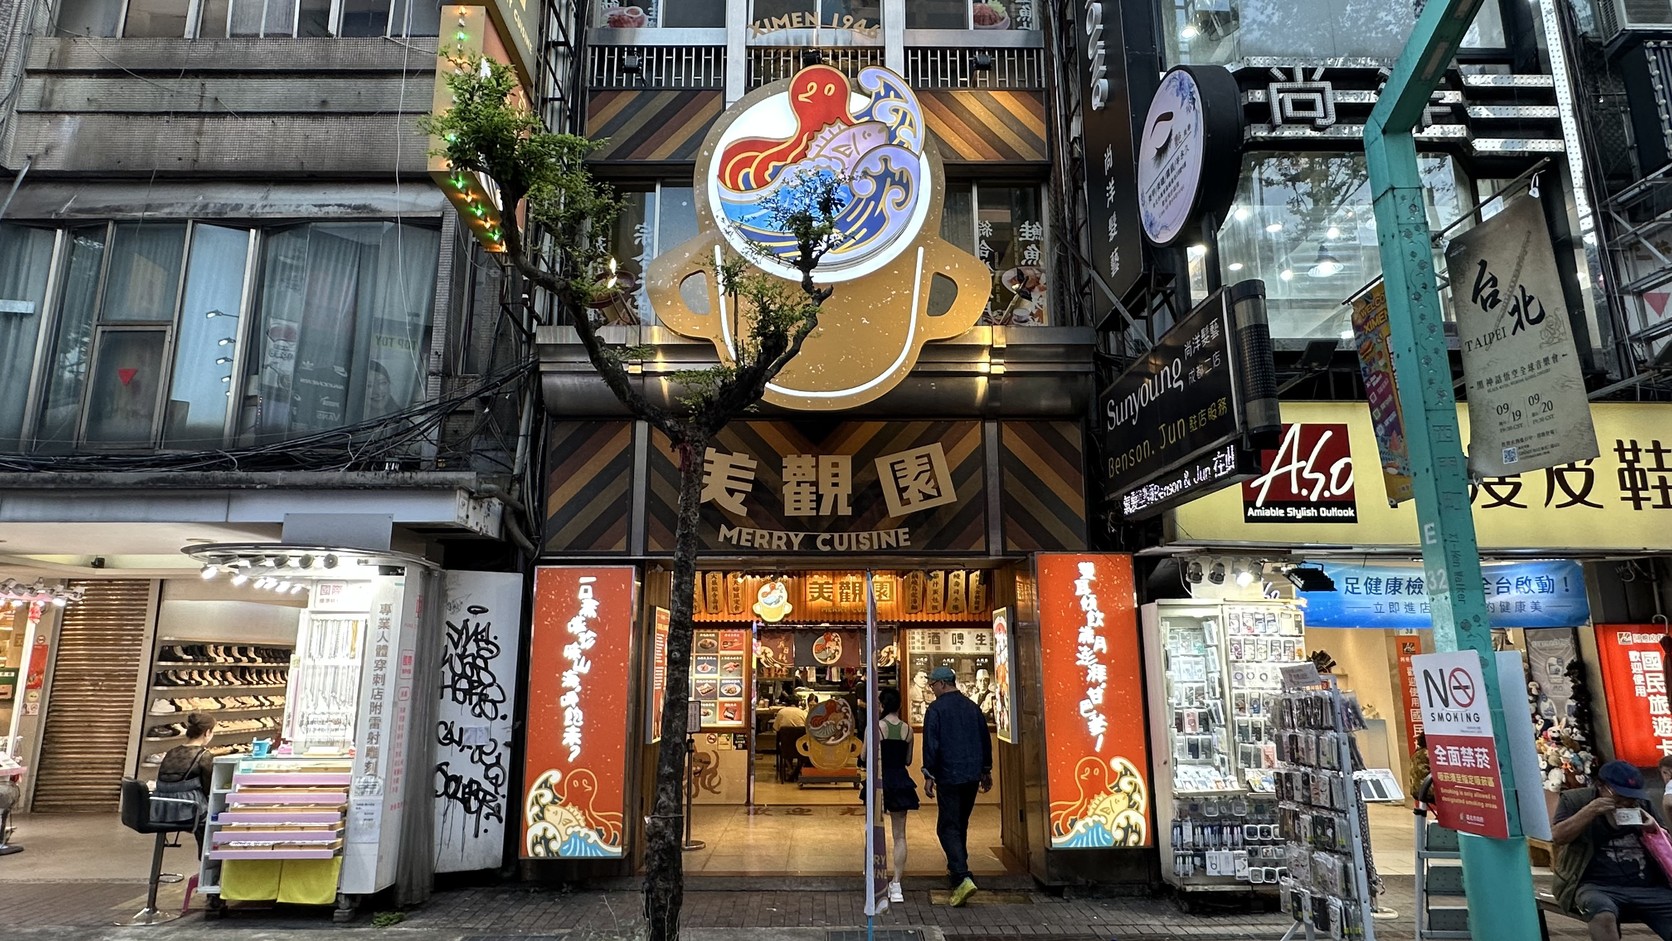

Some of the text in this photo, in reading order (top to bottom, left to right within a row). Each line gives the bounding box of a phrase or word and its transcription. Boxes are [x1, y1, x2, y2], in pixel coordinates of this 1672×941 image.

[751, 11, 880, 39] XIMEN 1946
[1104, 144, 1120, 278] 尚洋髮藝
[1471, 258, 1546, 336] 台北
[1184, 318, 1219, 360] 尚洋髮藝
[1465, 326, 1507, 352] TAIPEI
[1188, 351, 1221, 386] 成都二店
[1107, 357, 1183, 432] Sunyoung
[1528, 393, 1554, 413] 09 20
[1189, 396, 1228, 433] 駐店服務
[1496, 403, 1522, 422] 09 19
[1107, 418, 1186, 478] Benson. Jun
[700, 442, 958, 518] 美觀園
[1247, 507, 1355, 519] Amiable Stylish Outlook
[718, 524, 911, 550] MERRY CUISINE
[1423, 523, 1437, 544] E
[808, 580, 894, 602] 美觀園
[1344, 575, 1428, 597] 足健康檢
[1426, 568, 1449, 591] 32
[1453, 569, 1467, 605] Walker
[1373, 601, 1431, 614] 立即進店
[1628, 650, 1647, 698] 歡迎使用
[364, 603, 393, 778] 專業人體穿刺店附雷射雕刻
[1430, 712, 1481, 723] SMOKING
[1434, 744, 1491, 769] 全面禁菸
